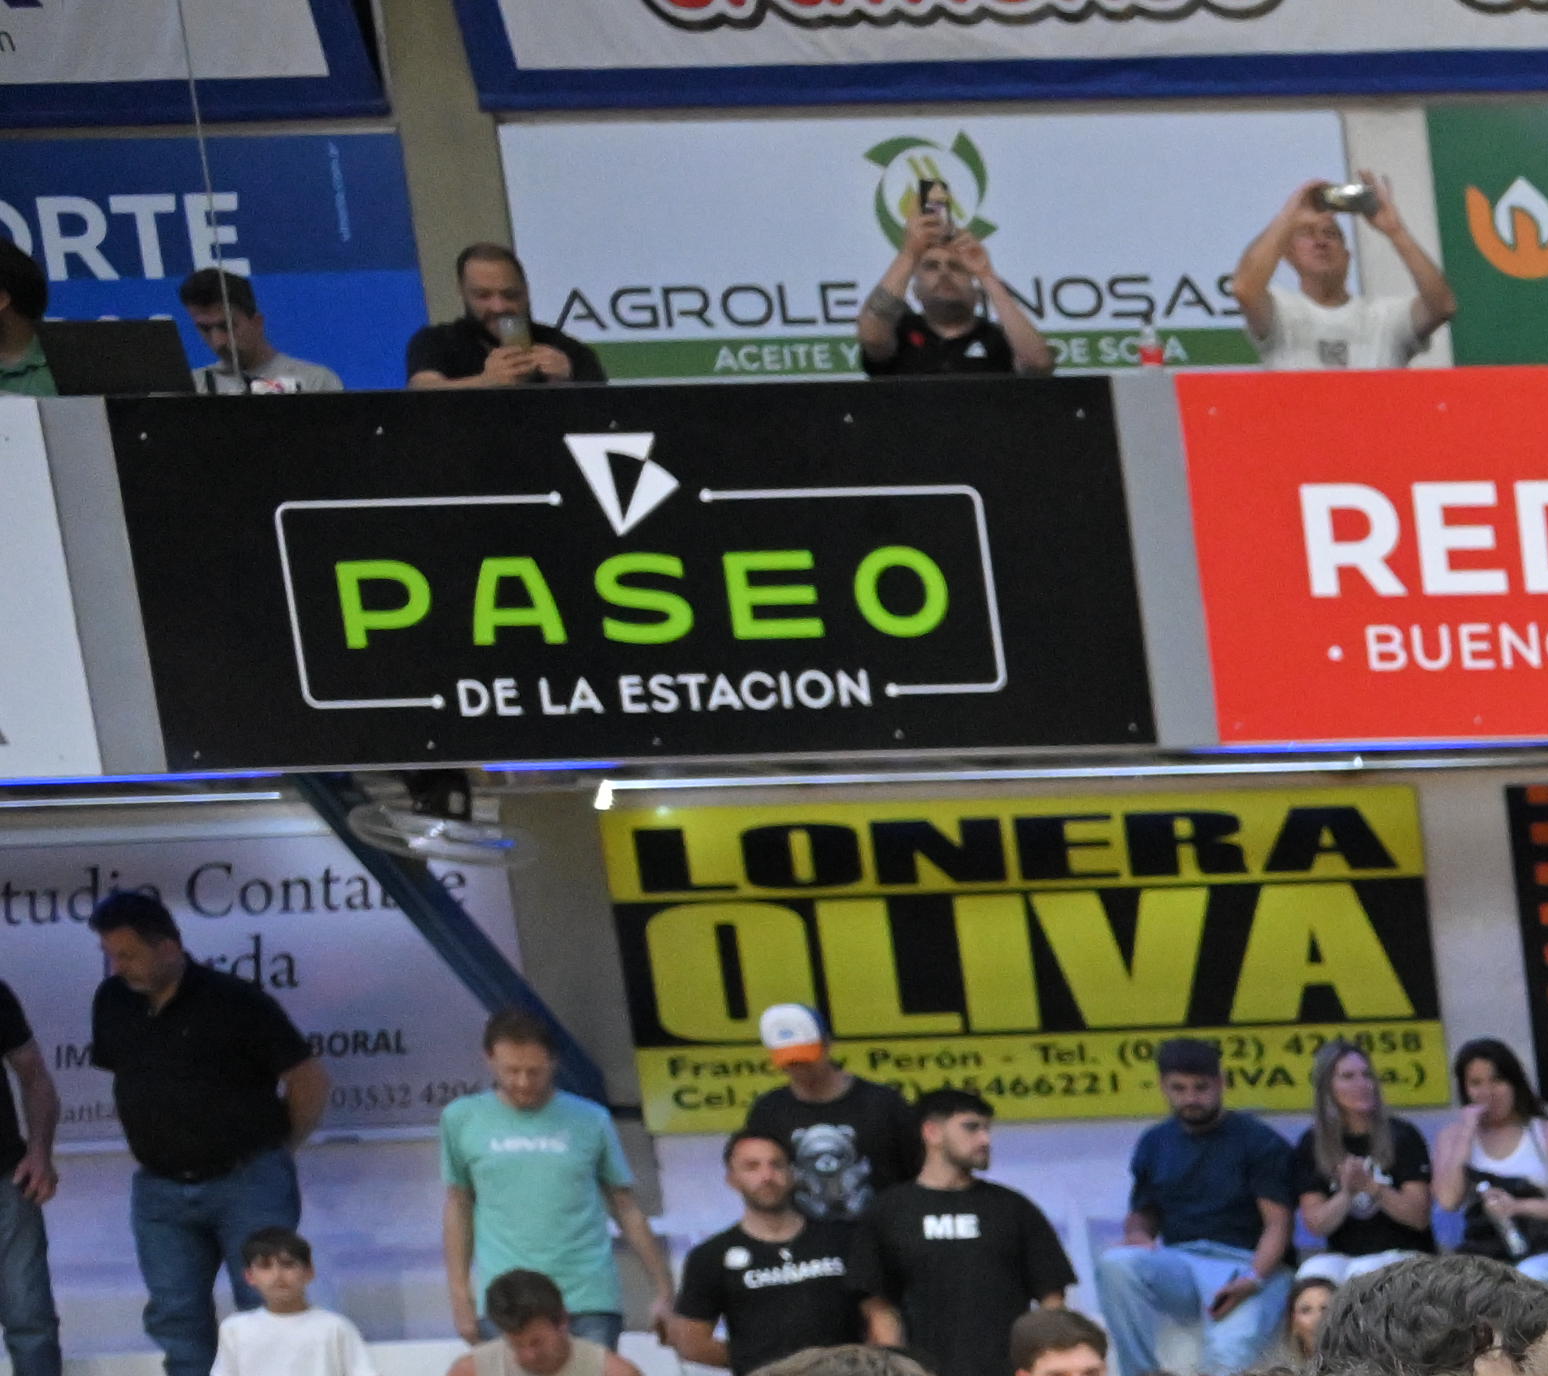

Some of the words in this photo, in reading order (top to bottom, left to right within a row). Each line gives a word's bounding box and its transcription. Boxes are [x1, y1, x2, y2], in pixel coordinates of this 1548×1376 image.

[554, 276, 1243, 331] AGROLENOSAS
[713, 341, 843, 373] ACEITE
[334, 546, 950, 650] PASEO
[456, 677, 528, 718] DE
[537, 675, 603, 717] LA
[619, 667, 873, 715] ESTACION
[633, 806, 1399, 894] LONERA
[184, 861, 468, 918] Contae
[643, 880, 1416, 1043] OLIVA
